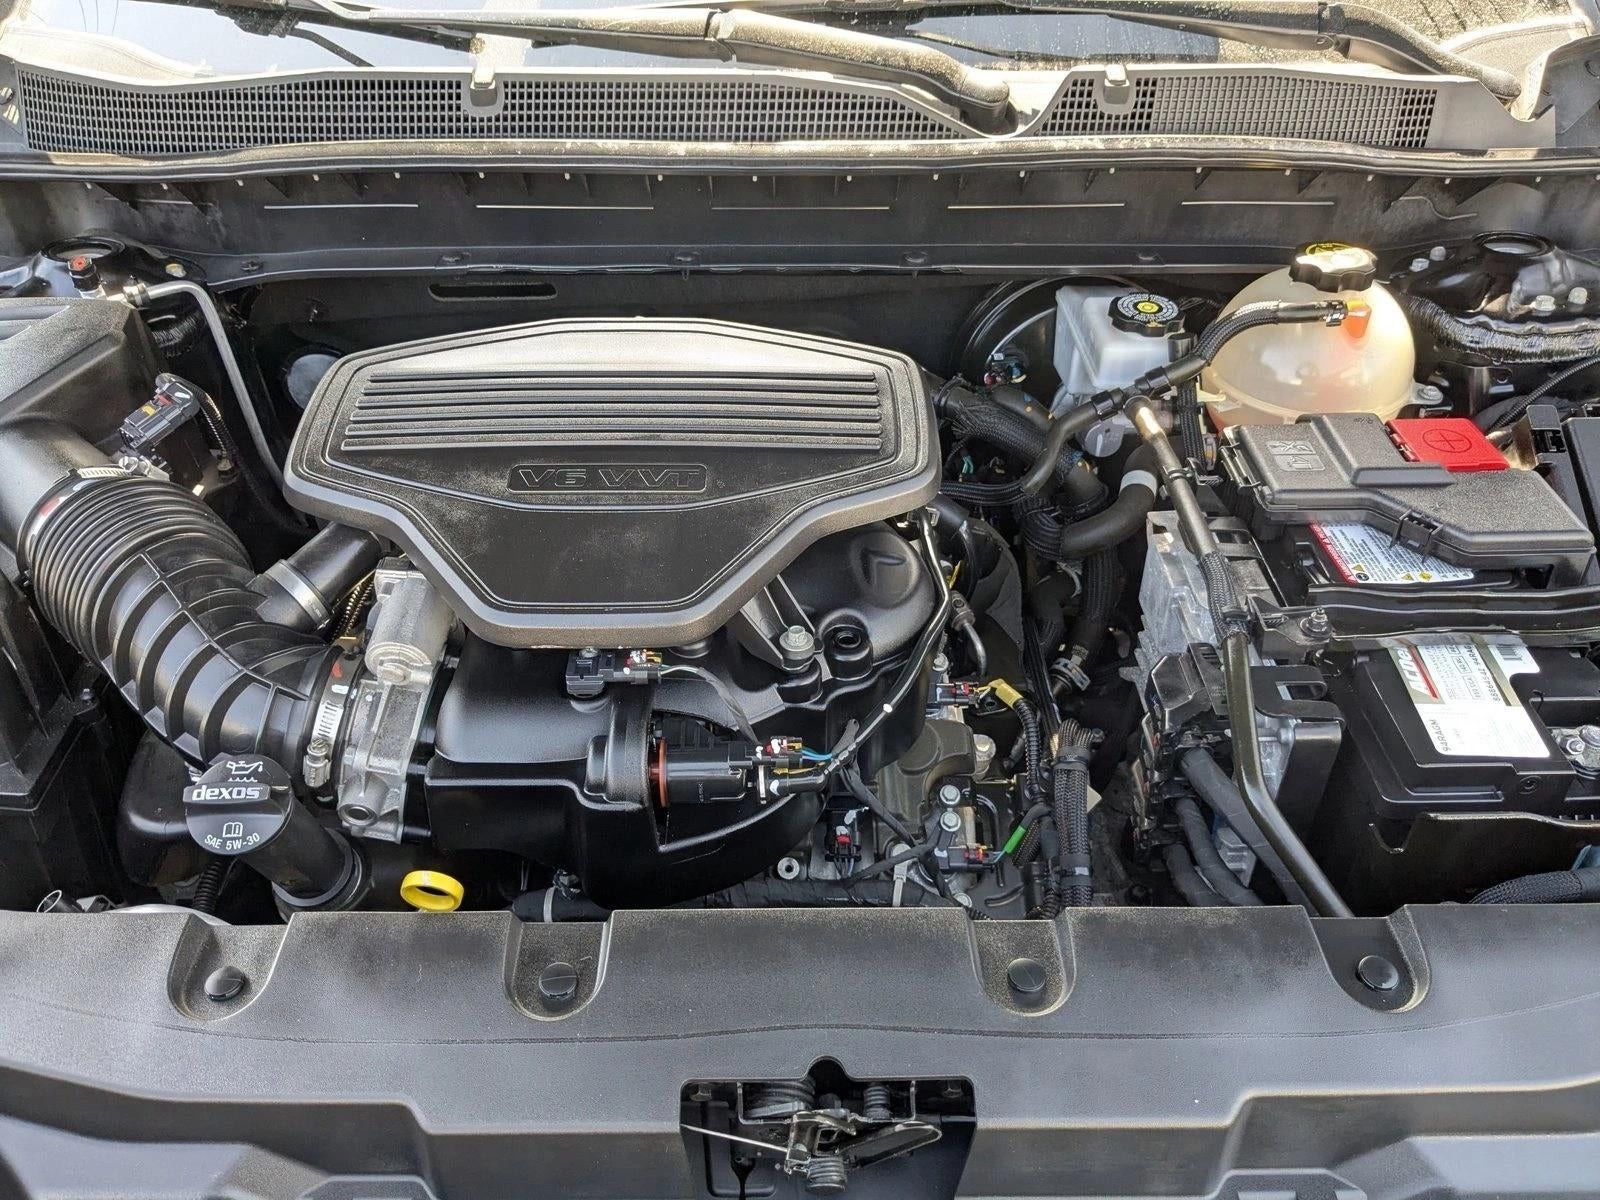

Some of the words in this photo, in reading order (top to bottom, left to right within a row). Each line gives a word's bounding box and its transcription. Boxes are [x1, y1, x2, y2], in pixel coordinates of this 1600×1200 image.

[519, 468, 587, 487] V6
[598, 468, 700, 487] VVT
[192, 785, 260, 800] dexos
[204, 834, 222, 849] SAE
[225, 832, 260, 850] 5W-30
